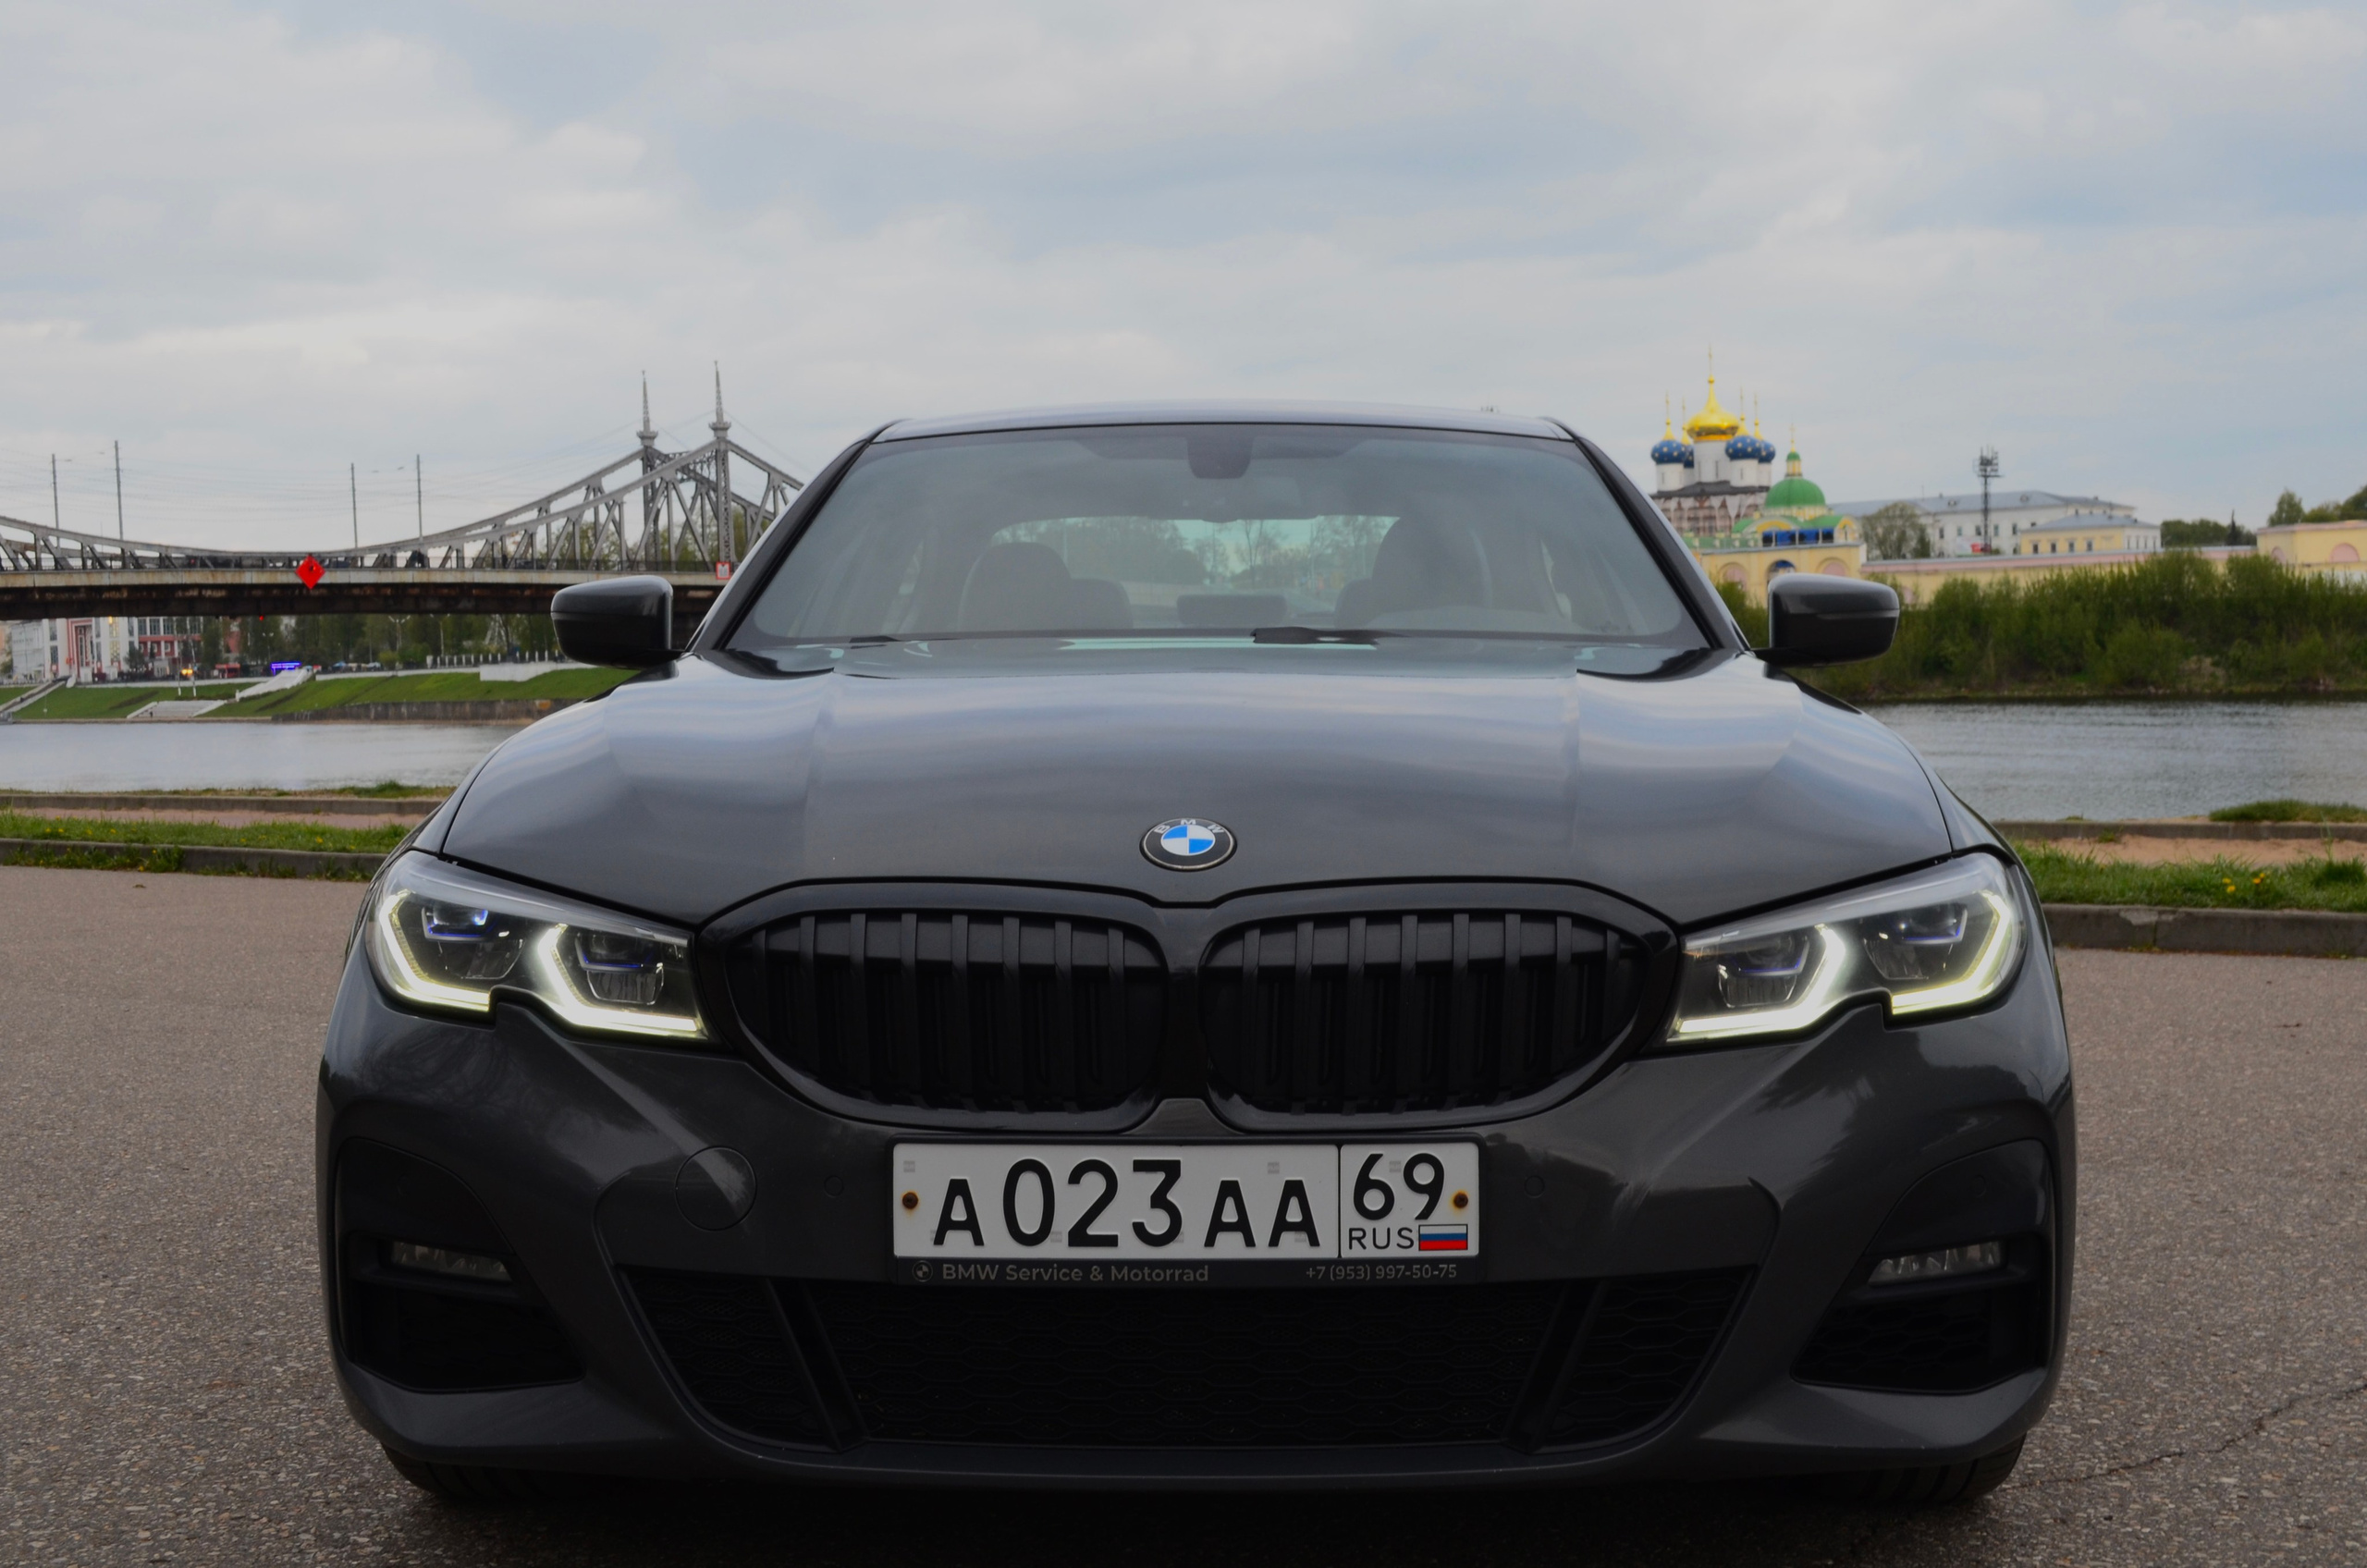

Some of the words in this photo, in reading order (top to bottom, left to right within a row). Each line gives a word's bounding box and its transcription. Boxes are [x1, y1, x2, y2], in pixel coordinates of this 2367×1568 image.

[1154, 819, 1225, 834] BMW
[1354, 1153, 1444, 1220] 69
[1349, 1227, 1415, 1250] RUS
[942, 1264, 999, 1280] BMW
[1006, 1263, 1083, 1281] Service
[1089, 1266, 1103, 1282] &
[1111, 1265, 1208, 1282] Motorrad
[1306, 1266, 1326, 1280] +7
[1330, 1264, 1370, 1281] (953)
[1375, 1264, 1457, 1280] 997-50-75
